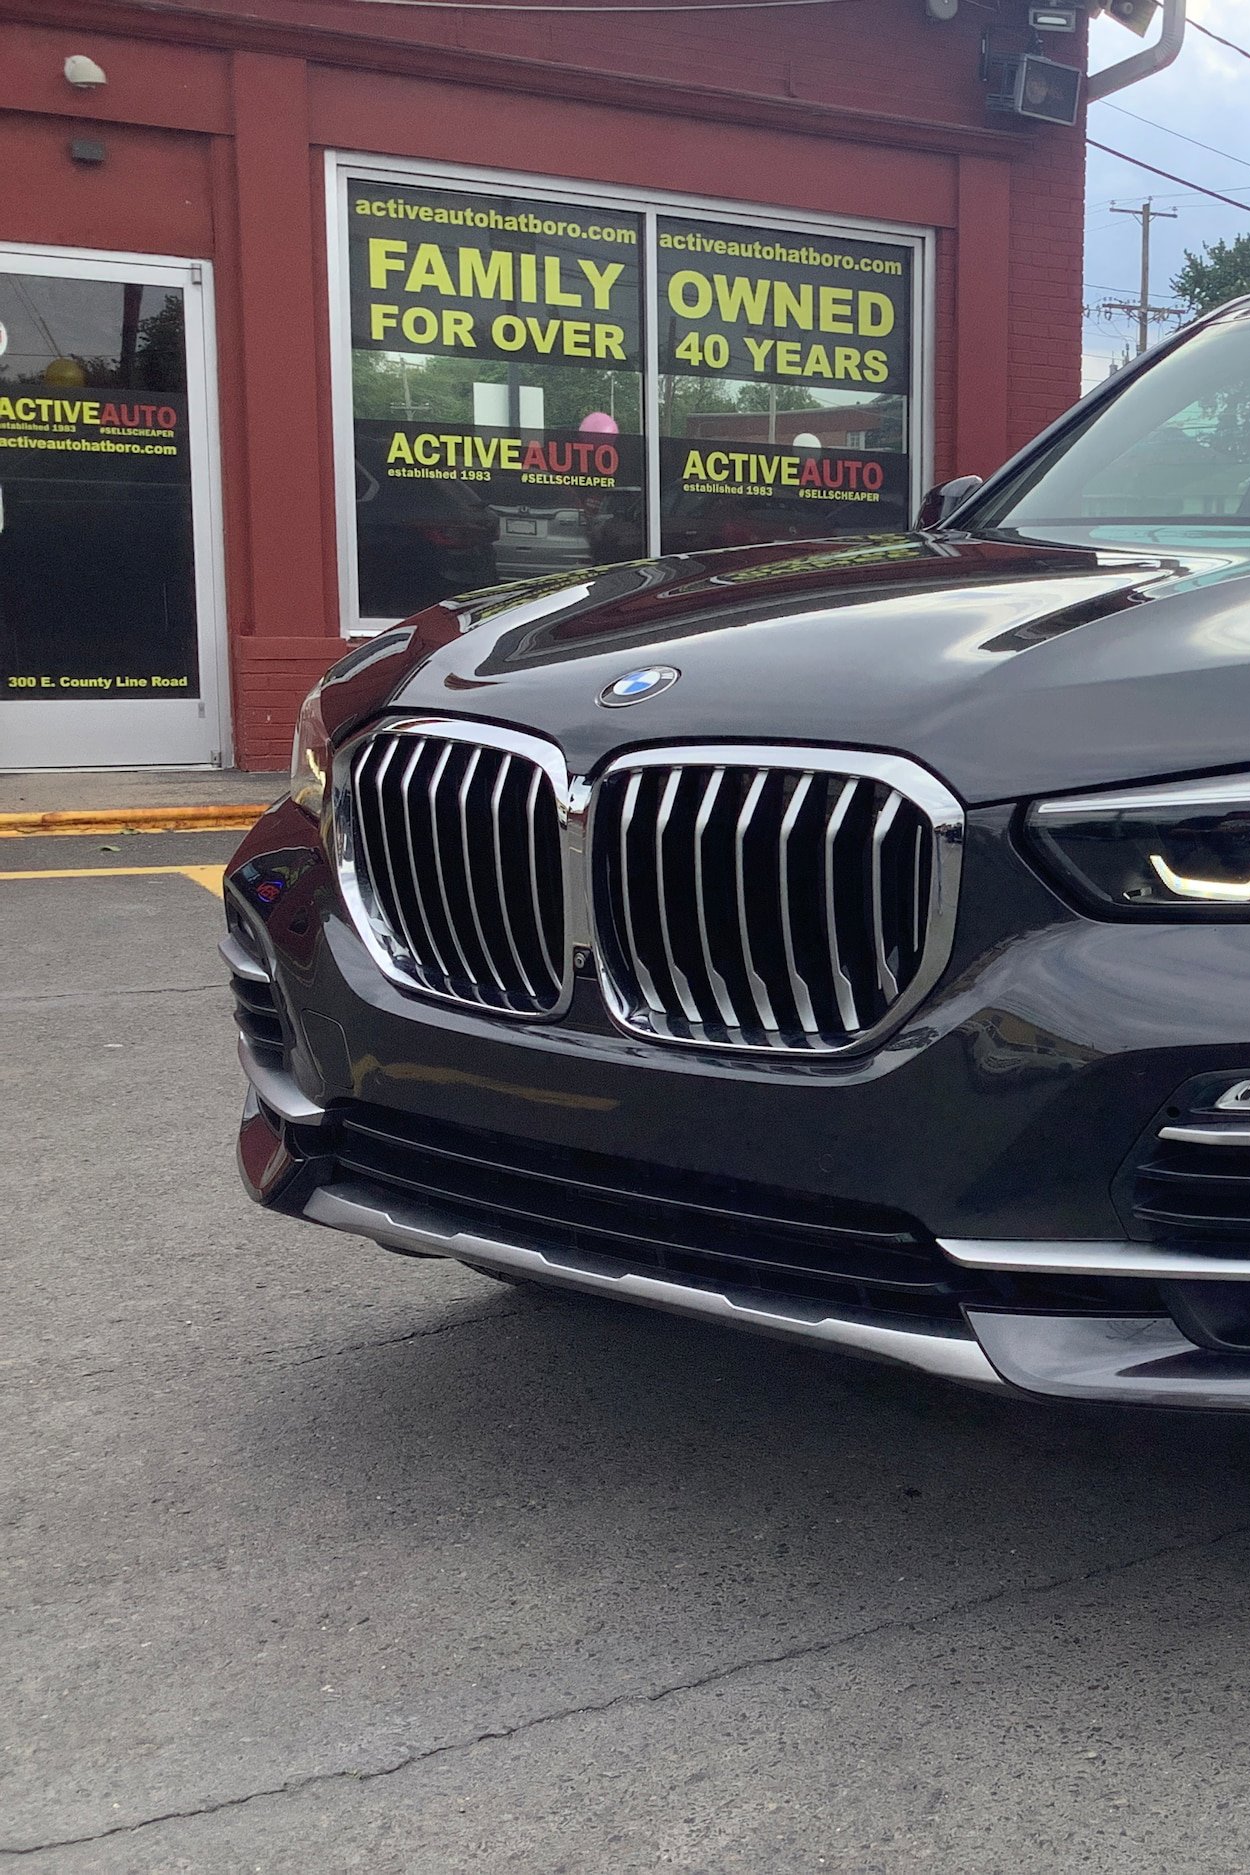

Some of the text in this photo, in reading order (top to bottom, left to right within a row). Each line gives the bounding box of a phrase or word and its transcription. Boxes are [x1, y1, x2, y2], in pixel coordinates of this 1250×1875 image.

[356, 200, 637, 244] activeautohatboro.com
[659, 233, 902, 275] activeautohatboro.com
[368, 237, 625, 311] FAMILY
[668, 270, 895, 338] OWNED
[370, 303, 627, 361] FOR OVER
[675, 332, 889, 383] 40 YEARS
[0, 397, 177, 428] ACTIVEAUTO
[0, 436, 177, 455] activeautohatboro.com
[100, 427, 175, 438] #SELLSCHEAPER
[386, 432, 619, 475] ACTIVEAUTO
[682, 450, 884, 490] ACTIVEAUTO
[387, 468, 492, 482] established 1983
[521, 473, 616, 488] #SELLSCHEAPER
[683, 483, 773, 497] established 1983
[799, 488, 880, 502] #SELLSCHEAPER
[8, 676, 188, 690] 300 E. County Line Road
